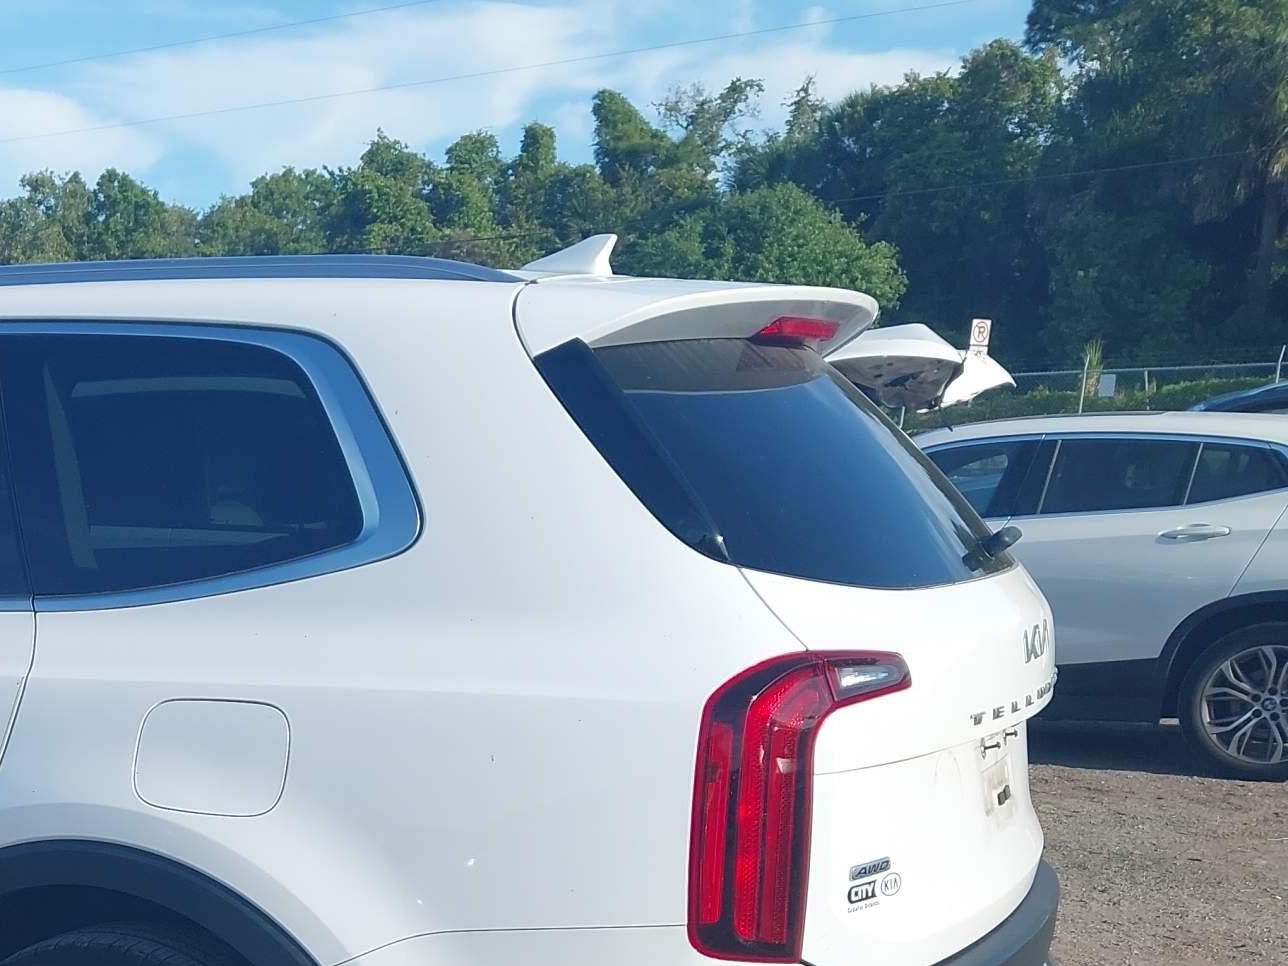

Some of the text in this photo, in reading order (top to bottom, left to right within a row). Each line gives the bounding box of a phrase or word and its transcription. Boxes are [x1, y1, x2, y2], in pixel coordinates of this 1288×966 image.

[855, 860, 890, 878] AWD
[850, 877, 899, 902] CITY KIA
